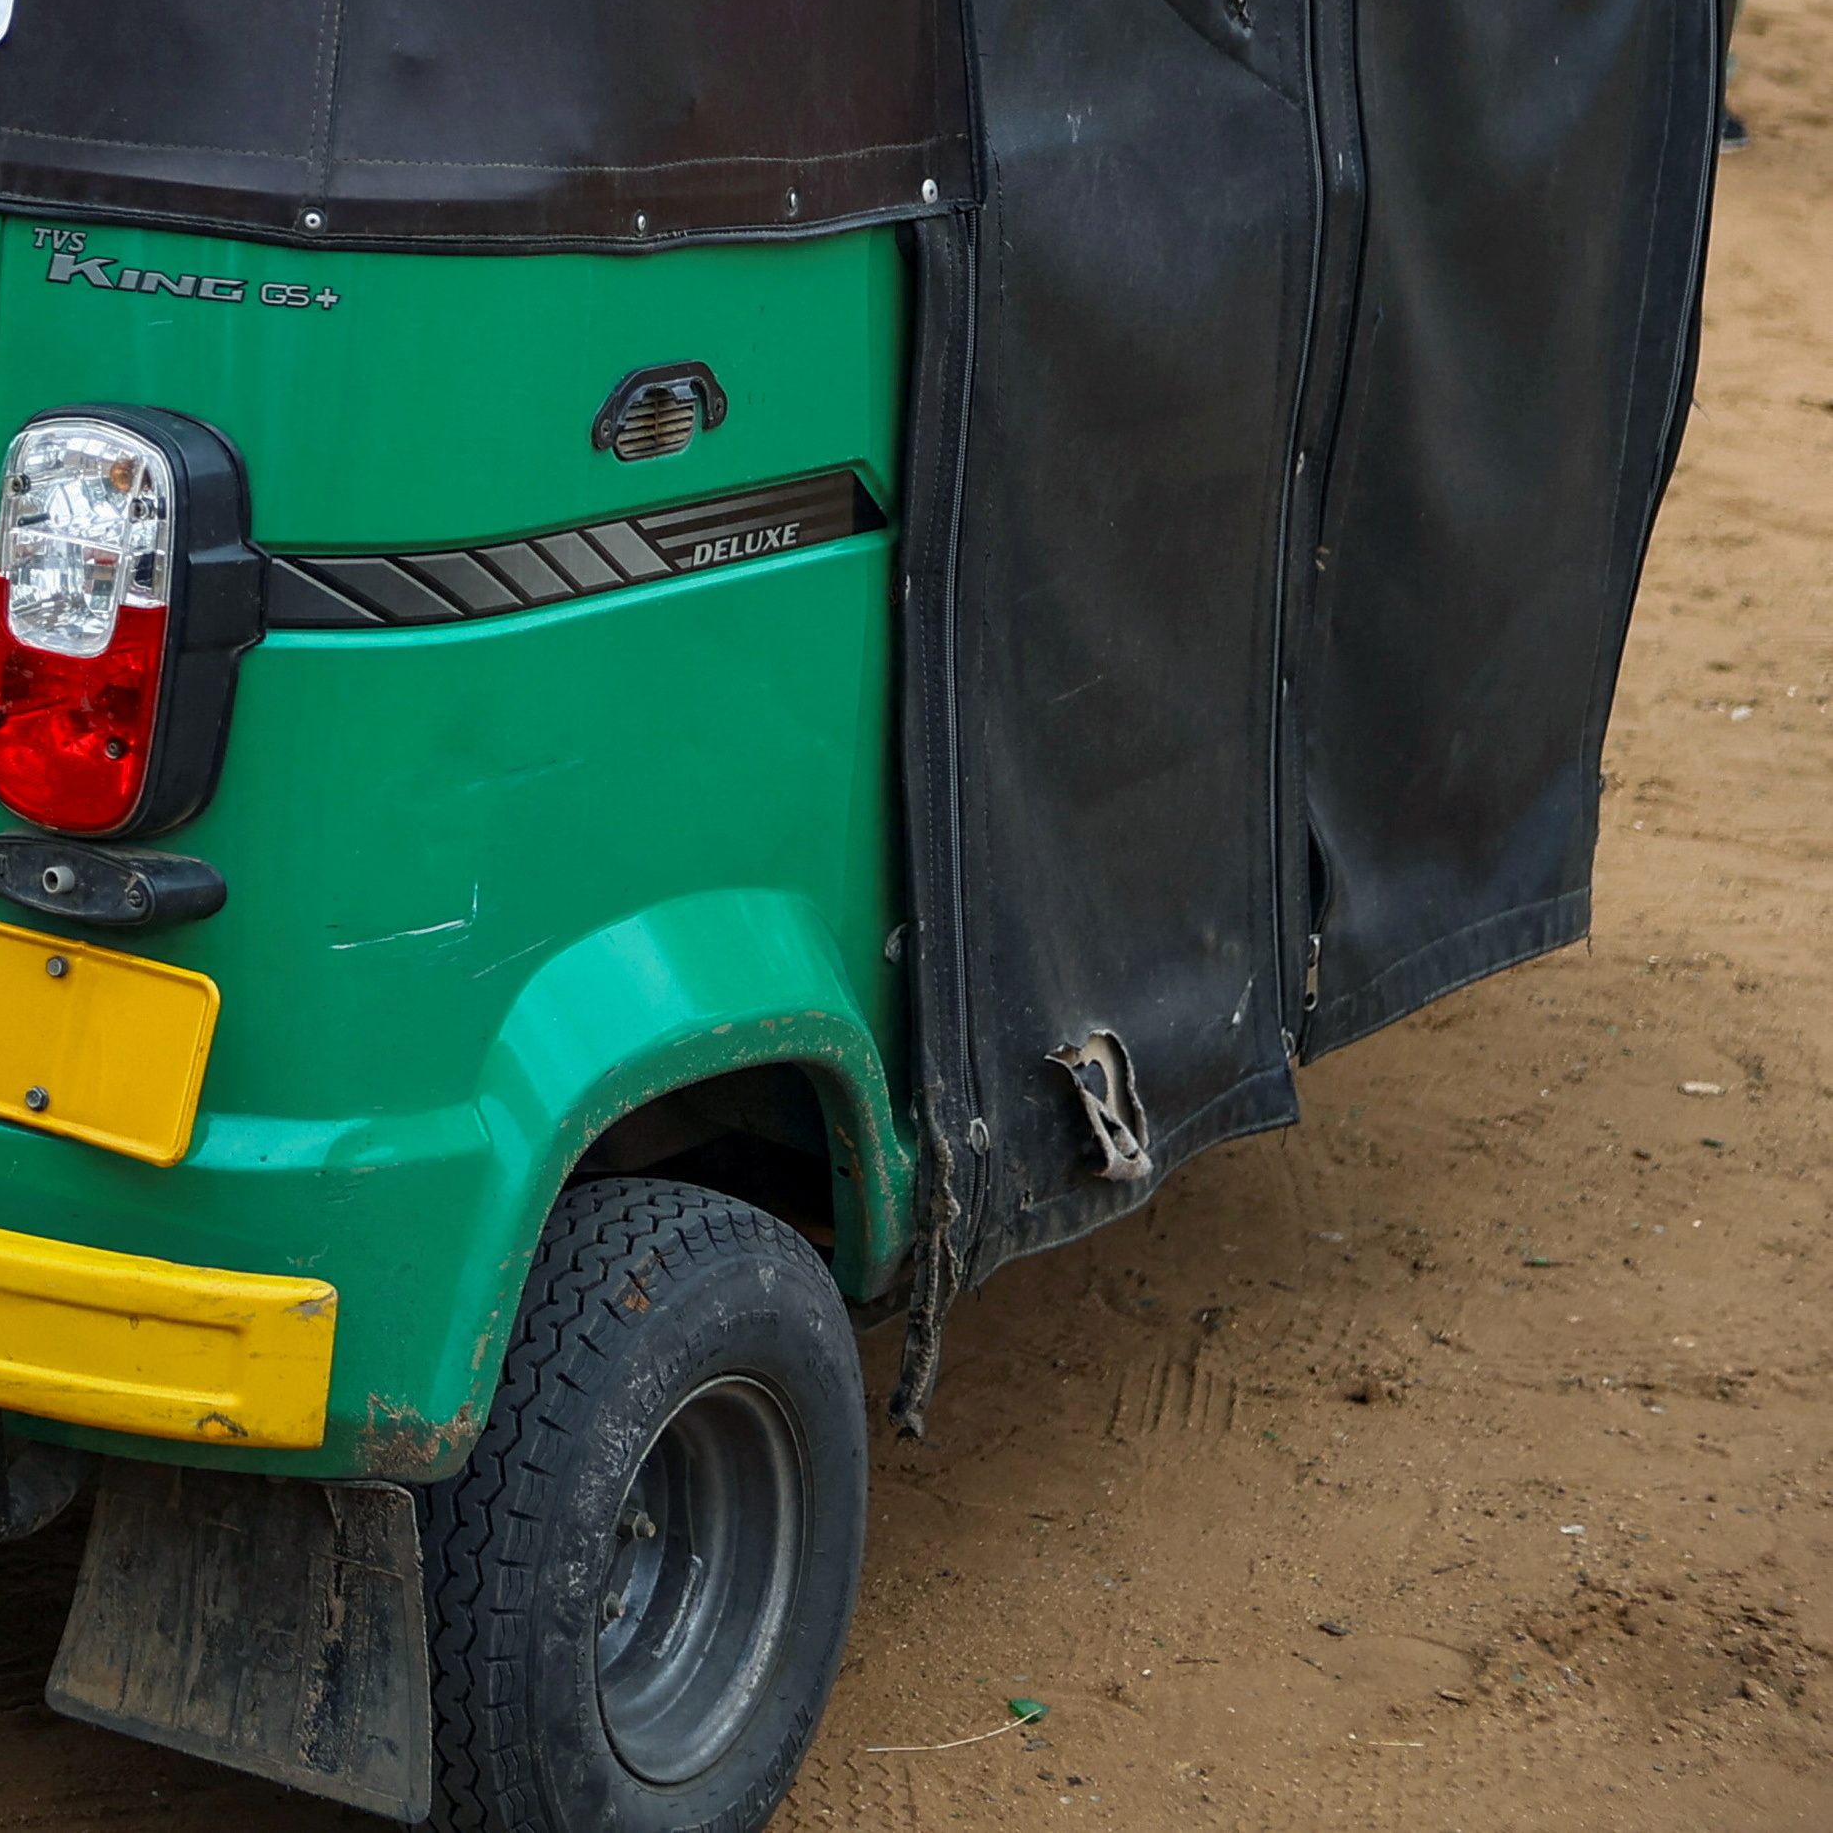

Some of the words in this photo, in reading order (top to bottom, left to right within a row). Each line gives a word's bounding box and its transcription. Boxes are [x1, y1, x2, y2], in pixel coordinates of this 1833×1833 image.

[33, 226, 87, 253] TVS
[260, 281, 341, 310] GS+
[690, 521, 801, 568] DELUXE
